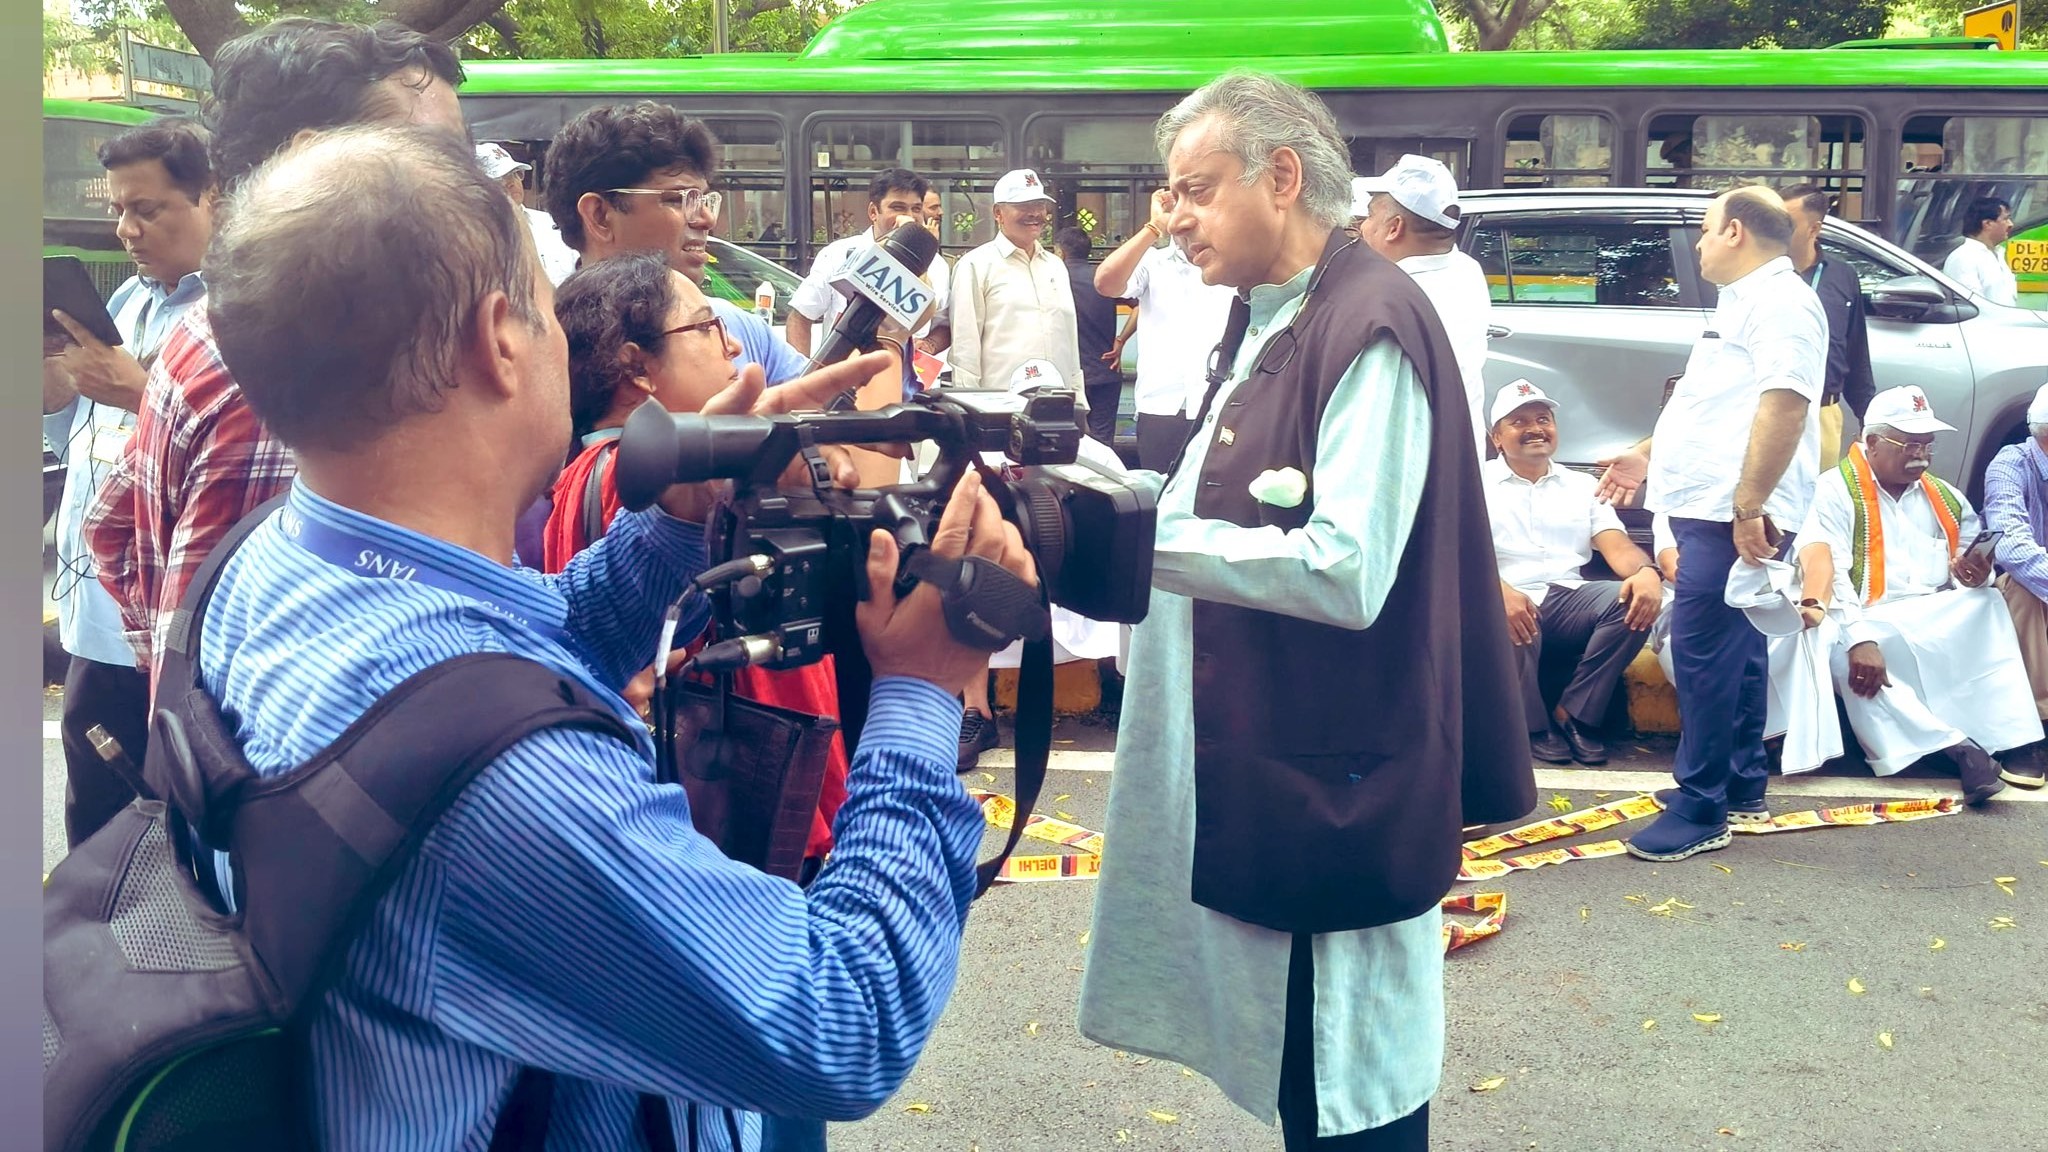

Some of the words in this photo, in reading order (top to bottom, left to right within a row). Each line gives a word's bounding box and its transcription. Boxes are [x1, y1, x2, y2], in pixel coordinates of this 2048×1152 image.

[856, 255, 928, 314] IANS
[865, 282, 879, 296] Wire
[879, 293, 900, 313] Service
[354, 549, 417, 581] IANS
[1019, 859, 1057, 872] DELHI
